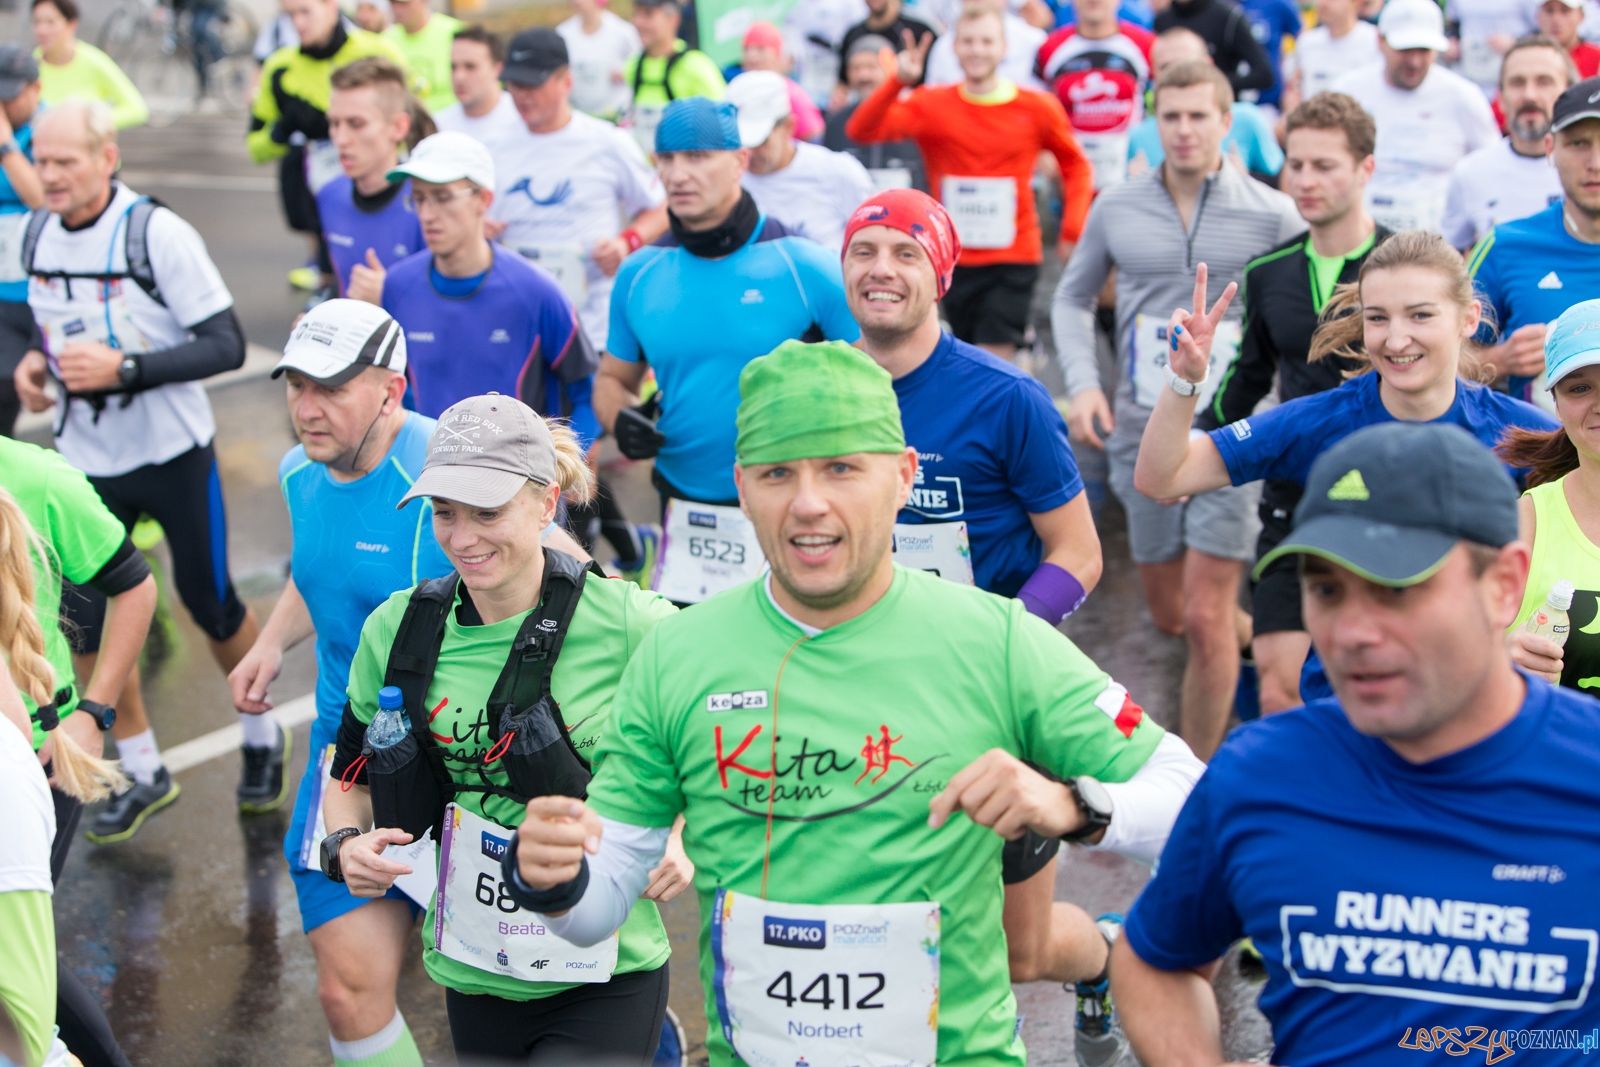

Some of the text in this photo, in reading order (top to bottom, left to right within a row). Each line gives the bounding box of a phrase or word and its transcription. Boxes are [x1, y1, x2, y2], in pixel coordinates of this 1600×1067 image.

[461, 414, 481, 424] RED
[482, 419, 503, 435] SOX
[432, 445, 484, 454] FENWAY PARK
[917, 452, 936, 461] RAFT
[355, 541, 382, 552] CRAFT
[689, 537, 745, 564] 6523
[899, 542, 933, 551] maraton
[714, 724, 856, 789] Kita
[740, 779, 832, 806] team
[1492, 864, 1550, 882] CRAFT
[498, 921, 546, 936] Beata
[767, 923, 822, 942] 17.PKO
[833, 934, 887, 944] maraton
[530, 960, 550, 969] 4F
[1299, 931, 1568, 994] WYZWANIE
[766, 971, 886, 1010] 4412
[787, 1020, 863, 1038] Norbert
